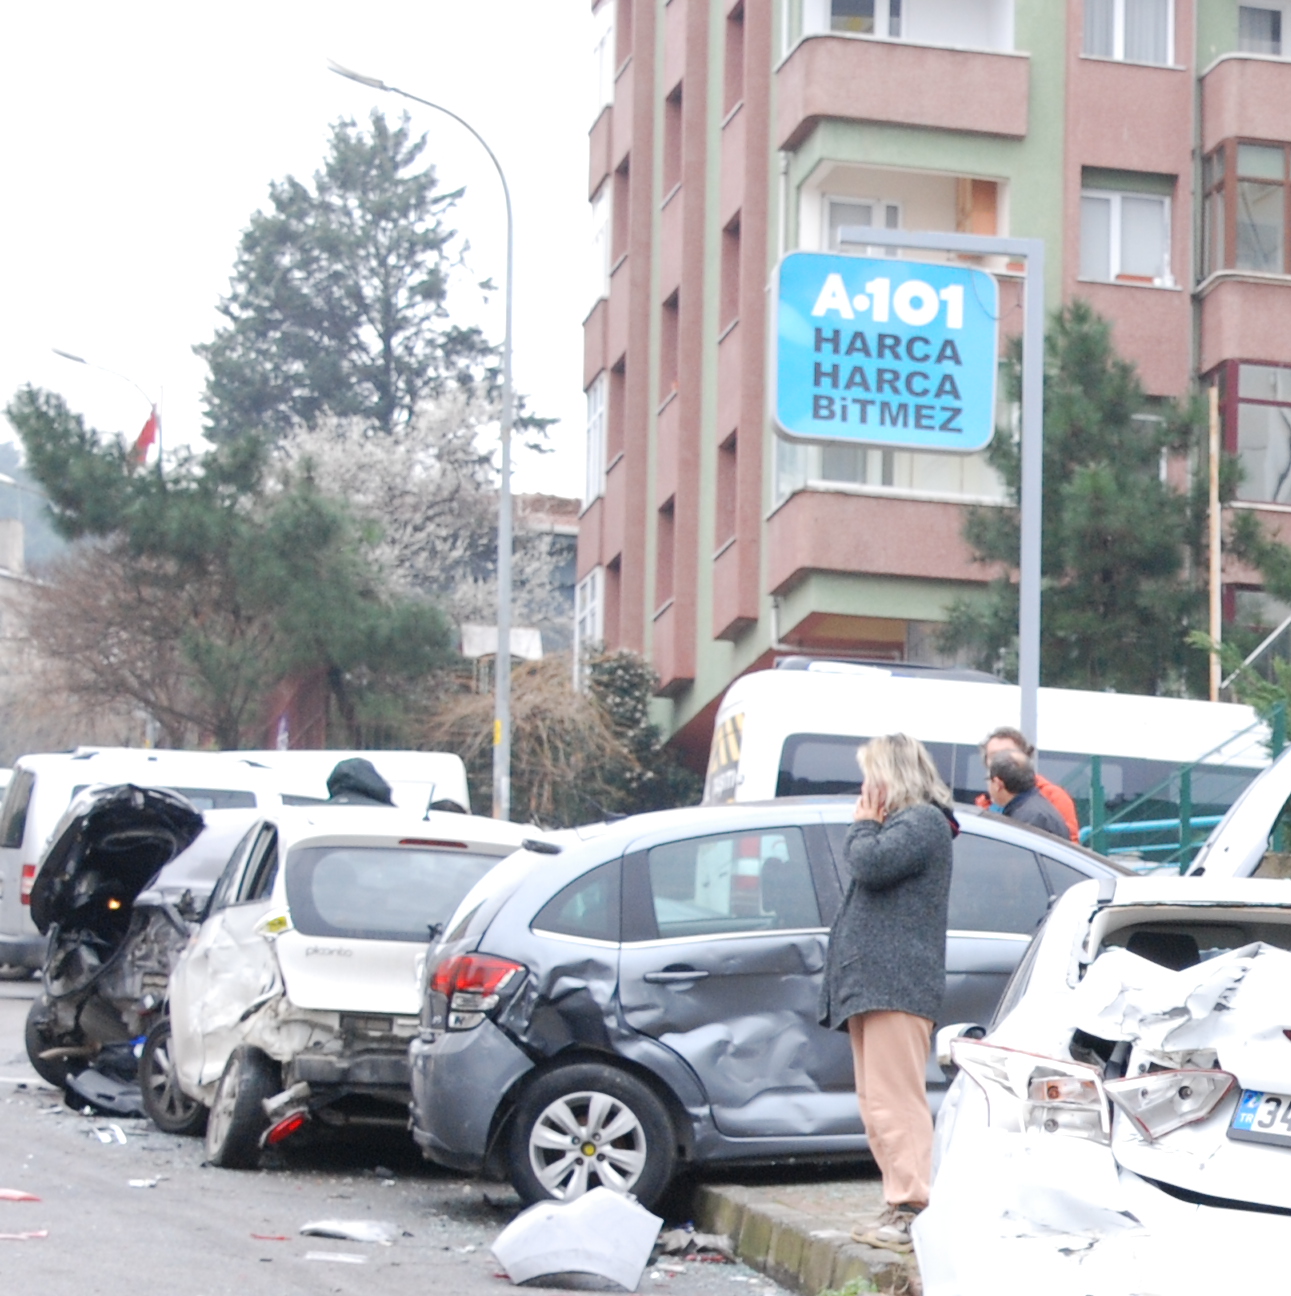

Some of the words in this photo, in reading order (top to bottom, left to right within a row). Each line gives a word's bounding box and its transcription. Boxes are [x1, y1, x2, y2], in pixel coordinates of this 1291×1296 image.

[813, 327, 963, 366] HARCA
[812, 362, 962, 401] HARCA
[1240, 1112, 1254, 1123] TR
